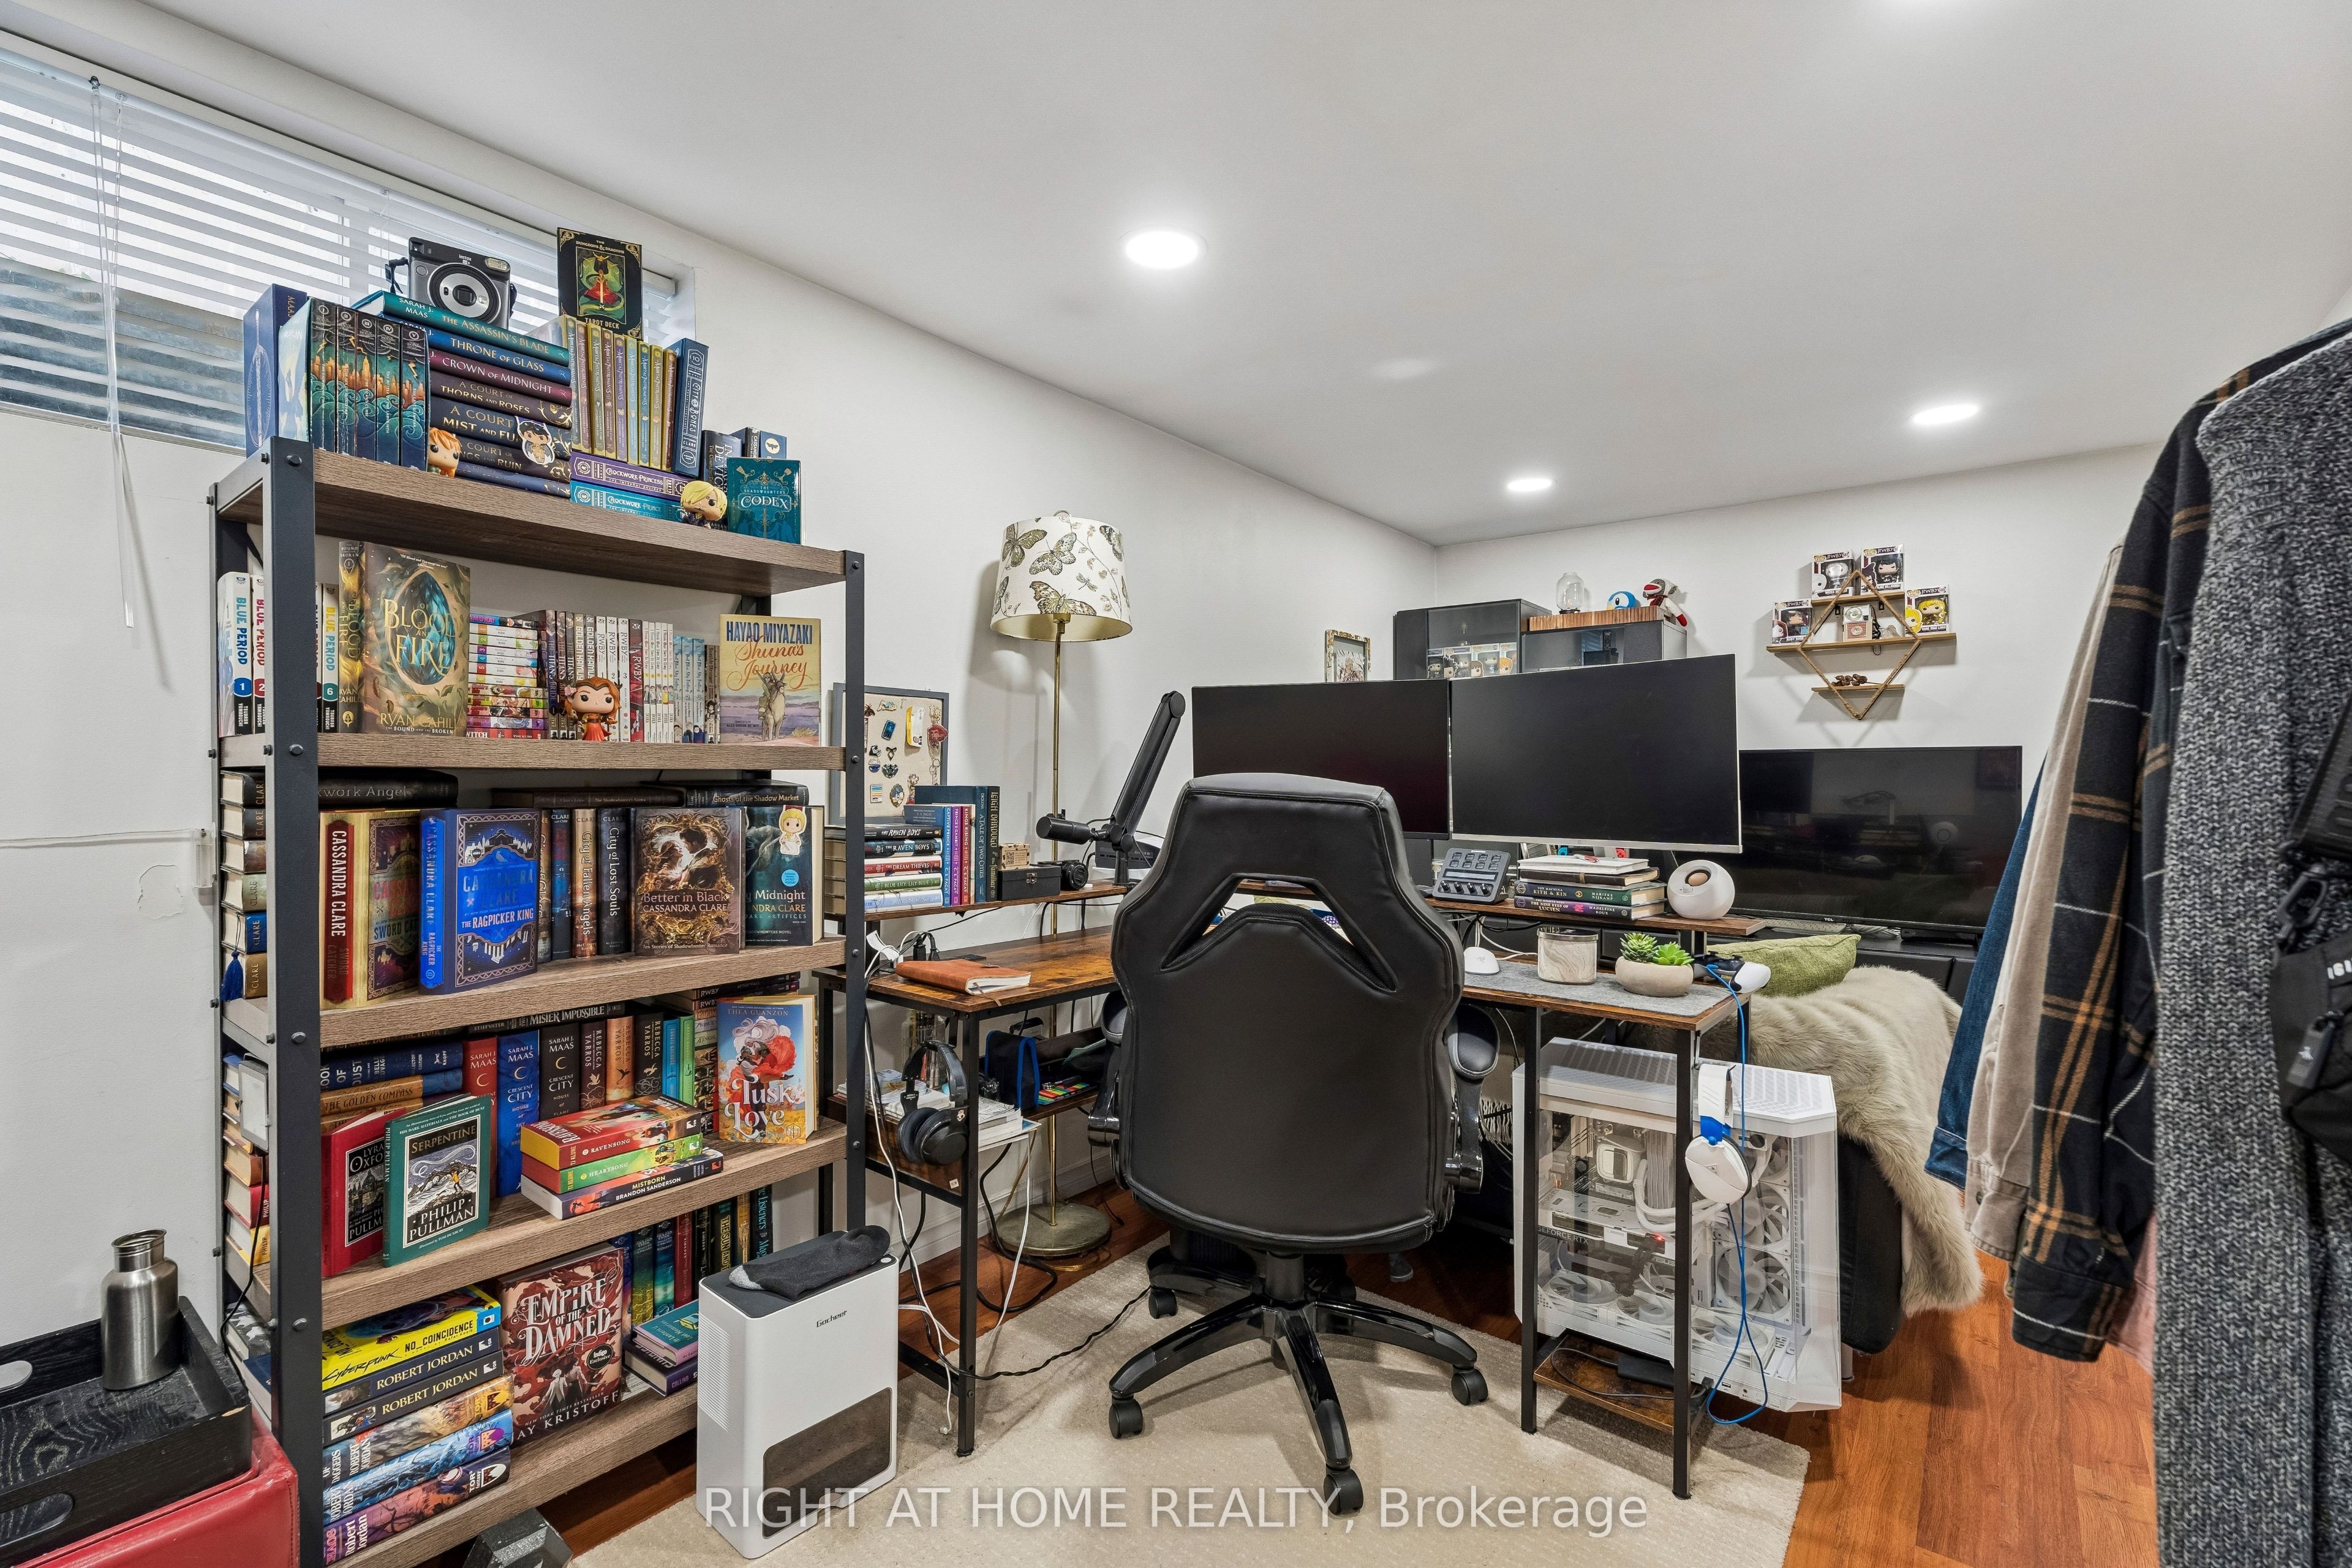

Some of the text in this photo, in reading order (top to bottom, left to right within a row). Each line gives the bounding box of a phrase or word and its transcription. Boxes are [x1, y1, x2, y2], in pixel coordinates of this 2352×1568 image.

[576, 241, 599, 249] DUNGEONS
[405, 307, 428, 318] MAAS
[442, 315, 549, 355] THE ASSASSIN'S BLADE
[585, 318, 619, 330] TAROT DECK
[451, 338, 497, 359] THRONE
[513, 357, 545, 372] GLASS
[442, 358, 485, 377] CROWN
[501, 374, 552, 394] MIDNIGHT
[441, 386, 483, 402] THORNS
[499, 401, 530, 414] ROSES
[690, 383, 701, 432] CITY BONES
[444, 417, 477, 432] MIST
[450, 406, 513, 428] A COURT
[466, 442, 502, 457] COURT
[684, 440, 696, 448] CLARE
[497, 458, 522, 471] RUIN
[606, 467, 663, 485] CLOCKWORK PRINCESS
[608, 496, 641, 510] CLOCKWORK
[741, 496, 788, 510] CODEX
[383, 599, 456, 638] BLOOD
[236, 597, 248, 665] BLUE PERIOD
[326, 607, 336, 671] BLUE PERIOD
[339, 616, 347, 647] FIRE
[726, 621, 813, 644] HAYAO MIYAZAKI
[396, 634, 450, 676] FIRE
[576, 626, 584, 680] GOLDEN KAMUY
[735, 635, 804, 665] Shuna's
[632, 657, 641, 682] RWBY
[727, 658, 813, 691] Journey
[380, 713, 458, 729] RYAN CAHILL
[366, 786, 407, 802] Angel
[606, 827, 620, 916] City of Lost Souls
[331, 831, 347, 937] CASSANDRA CLARE
[644, 892, 727, 903] Better in Black
[756, 889, 806, 903] Midnight
[473, 911, 514, 929] RAGPICKER
[518, 908, 533, 921] KING
[643, 904, 697, 913] CASSANDRA
[701, 987, 719, 997] RWBY
[562, 1006, 605, 1021] IMPOSSIBLE
[508, 1051, 533, 1062] MAAS
[549, 1042, 574, 1053] MAAS
[470, 1058, 497, 1069] MAAS
[508, 1084, 533, 1094] CRESCENT
[549, 1074, 574, 1083] CRESCENT
[549, 1080, 574, 1092] CITY
[731, 1074, 797, 1104] Tusk
[325, 1087, 413, 1112] THE GOLDEN COMPASS
[508, 1090, 533, 1102] CITY
[725, 1102, 785, 1139] Love
[412, 1125, 476, 1154] SERPENTINE
[591, 1139, 630, 1153] RAVENSONG
[589, 1163, 628, 1177] HEARTSONG
[616, 1177, 681, 1201] BRANDON SANDERSON
[632, 1175, 666, 1189] MISTBORN
[421, 1198, 465, 1224] PHILIP
[758, 1196, 767, 1230] Listeners
[409, 1206, 474, 1241] PULLMAN
[720, 1215, 730, 1266] THE SUN AND
[1538, 1226, 1589, 1245] GEFORCE RTX
[517, 1278, 608, 1326] EMPIRE
[556, 1308, 582, 1326] OF THE
[816, 1310, 848, 1328] Gocheer
[518, 1308, 611, 1361] DAMNED
[589, 1354, 611, 1365] Exclusive
[594, 1349, 608, 1359] Indigo
[377, 1345, 473, 1390] ROBERT JORDAN
[382, 1368, 478, 1415] ROBERT JORDAN
[672, 1375, 689, 1389] COLLINS
[574, 1392, 604, 1407] BESTSELLER
[510, 1391, 619, 1444] JAY KRISTOFF
[349, 1443, 360, 1476] ROBERT
[361, 1438, 371, 1471] JORDAN
[331, 1449, 341, 1485] DAGGERS
[345, 1519, 356, 1556] Robert
[358, 1513, 368, 1550] Jordan
